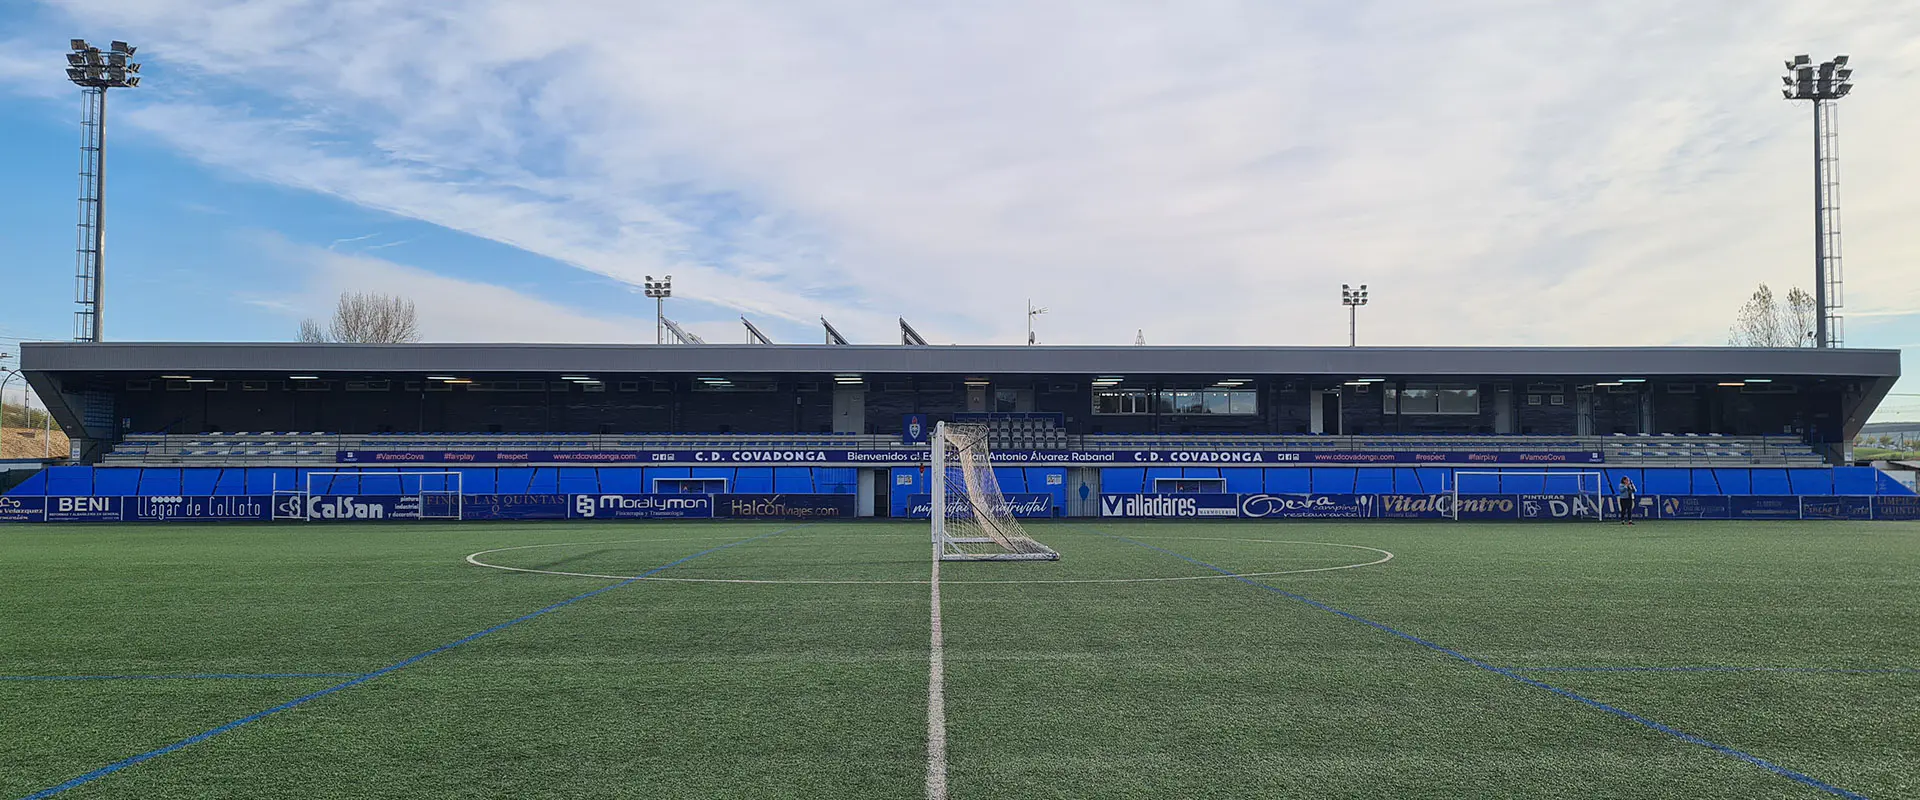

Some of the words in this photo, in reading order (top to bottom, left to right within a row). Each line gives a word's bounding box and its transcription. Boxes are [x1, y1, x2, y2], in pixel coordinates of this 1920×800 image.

[444, 453, 475, 461] #fairplay
[497, 453, 528, 461] #respect
[553, 453, 636, 461] www.cdcovadonga.com
[732, 451, 826, 461] COVADONGA
[848, 451, 908, 461] Bienvenidos
[989, 451, 1027, 461] Antonio
[1030, 450, 1069, 461] Álvarez
[1072, 451, 1114, 461] Rabanal
[1170, 451, 1263, 462] COVADONGA
[1315, 453, 1395, 461] www.cdcovadonga.com
[1416, 453, 1446, 461] #respect
[1469, 453, 1498, 461] #fairplay
[1520, 453, 1566, 461] #VamosCova
[59, 497, 110, 511] BENI
[474, 496, 499, 505] LAS
[503, 495, 565, 505] QUINTAS
[600, 495, 707, 510] Moralymon
[1382, 495, 1514, 513] VitalCentro
[187, 496, 201, 516] de
[209, 496, 260, 516] Colloto
[309, 496, 383, 519] CalSan
[1313, 504, 1357, 514] camping
